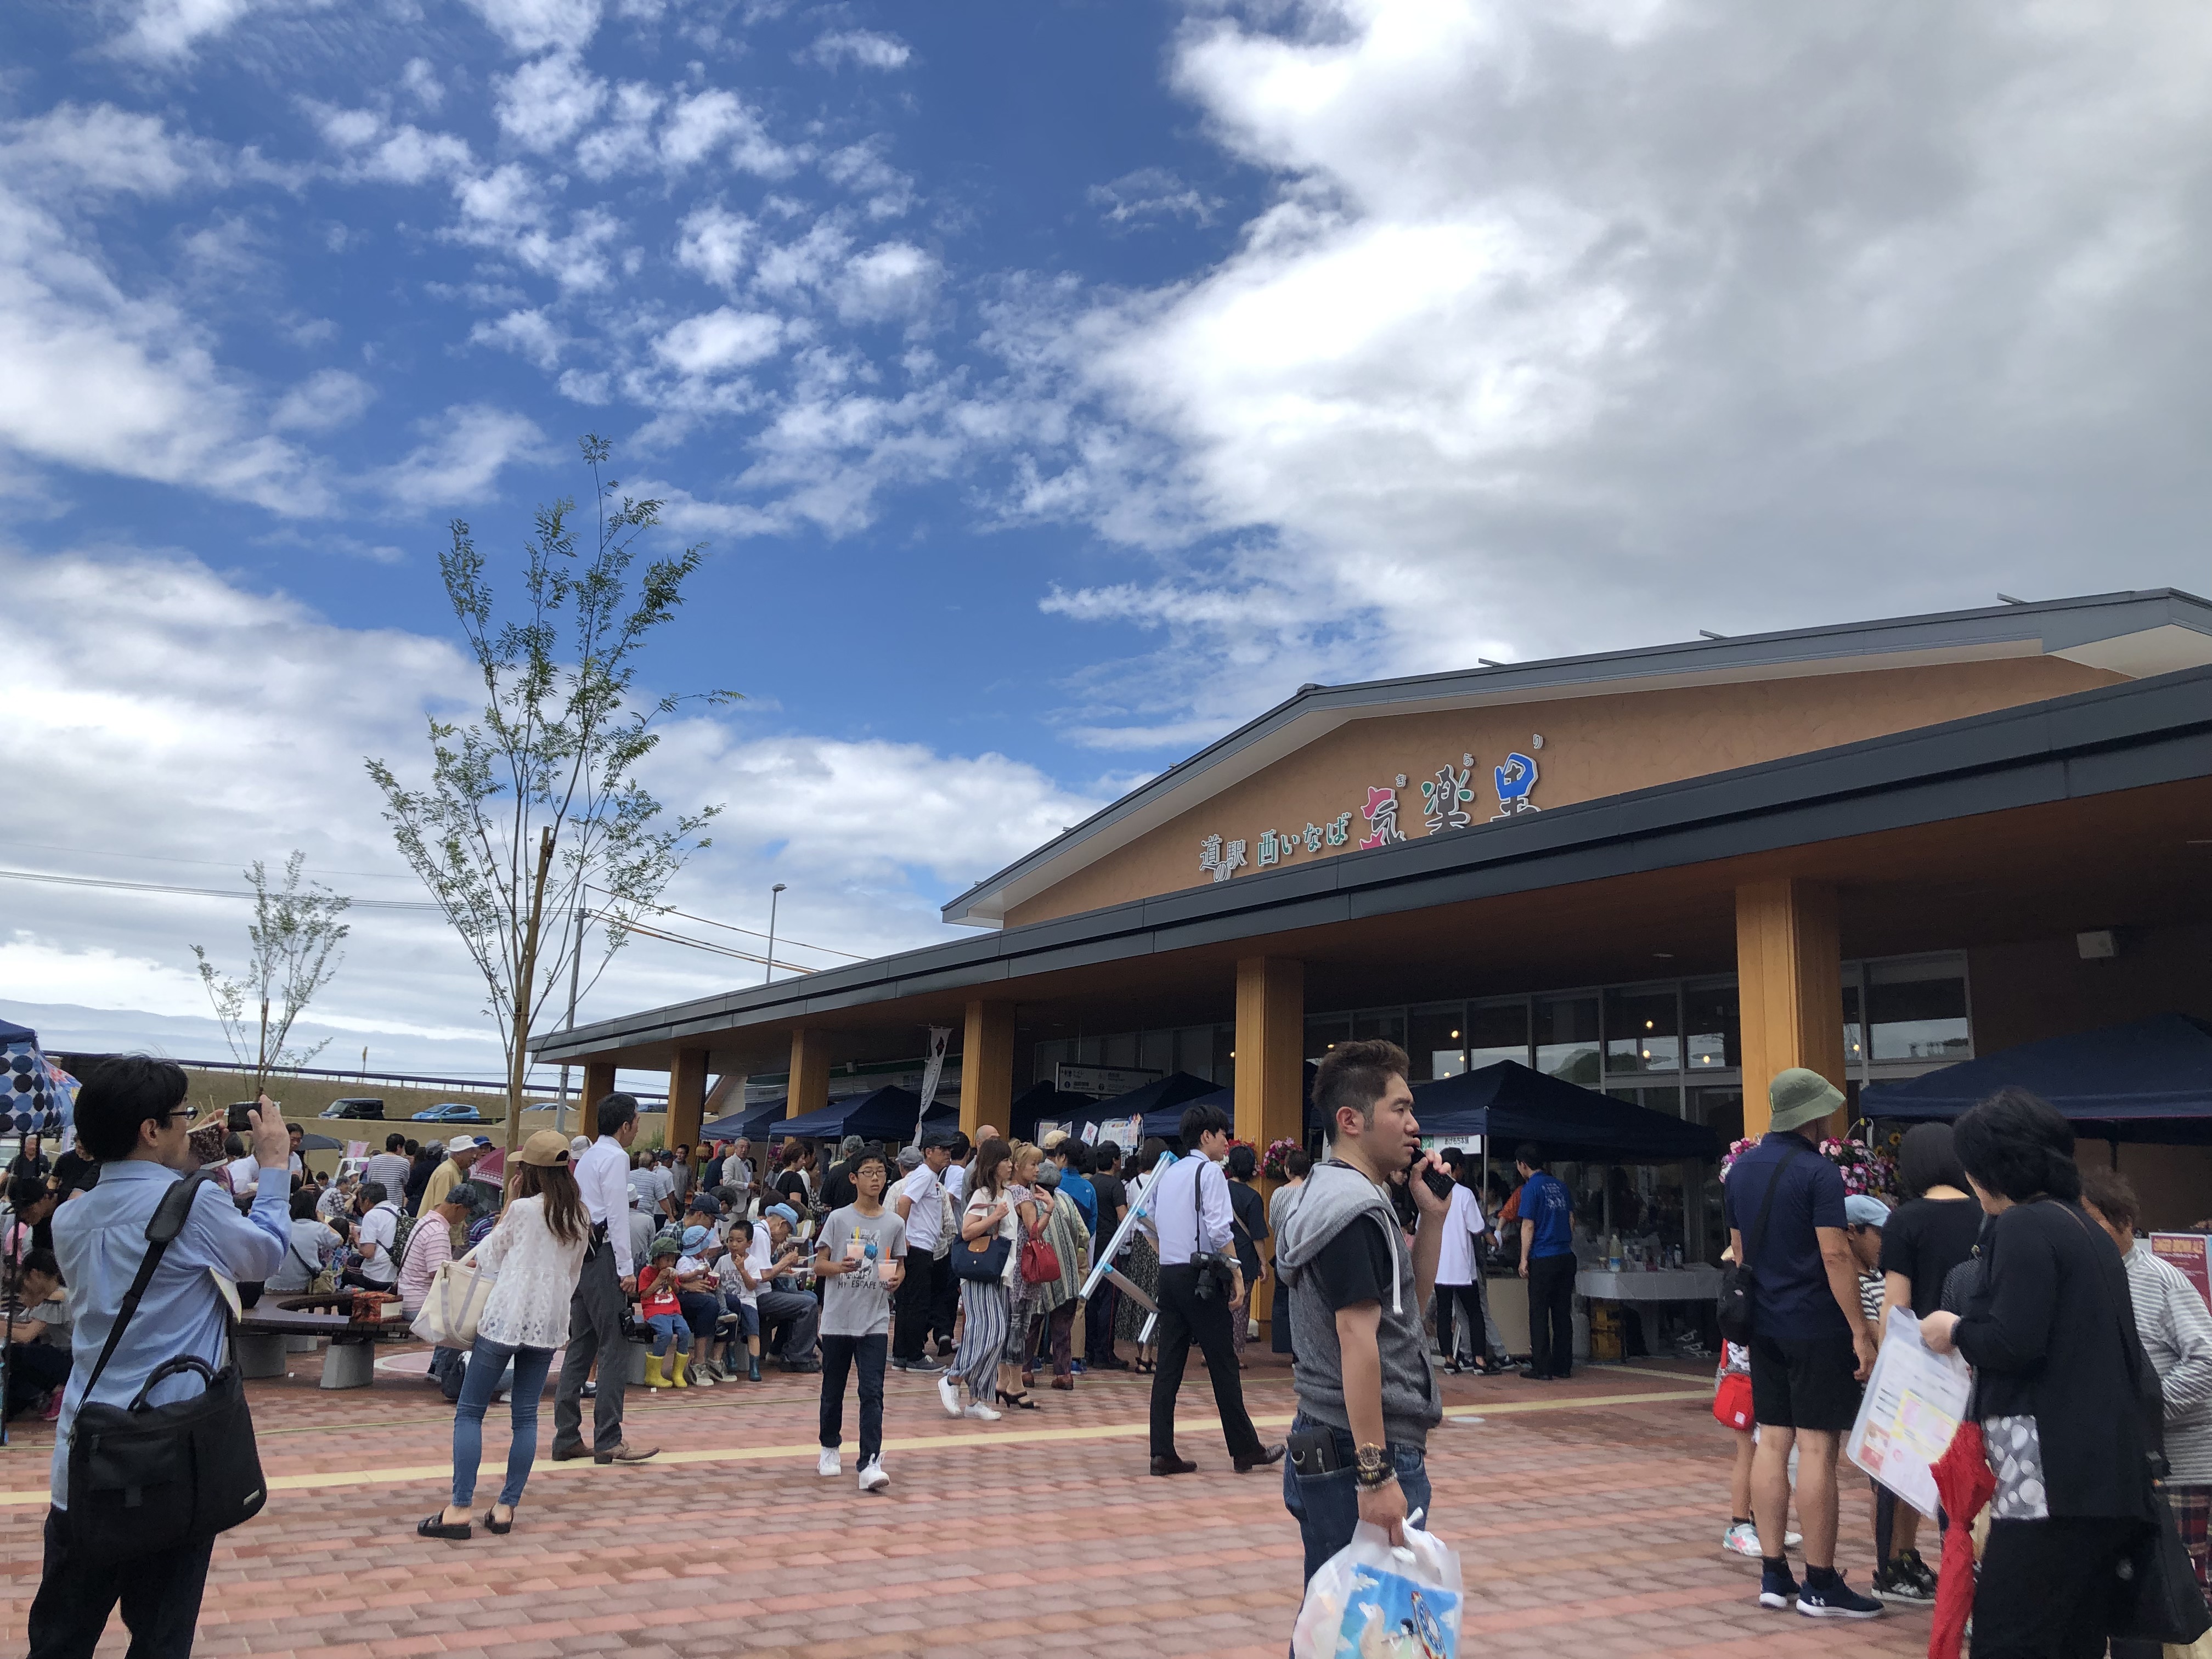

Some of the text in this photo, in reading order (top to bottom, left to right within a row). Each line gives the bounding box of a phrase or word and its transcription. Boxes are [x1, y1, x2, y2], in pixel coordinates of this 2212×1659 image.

[1257, 812, 1352, 867] 西いなば
[851, 1279, 877, 1290] ESCAPE
